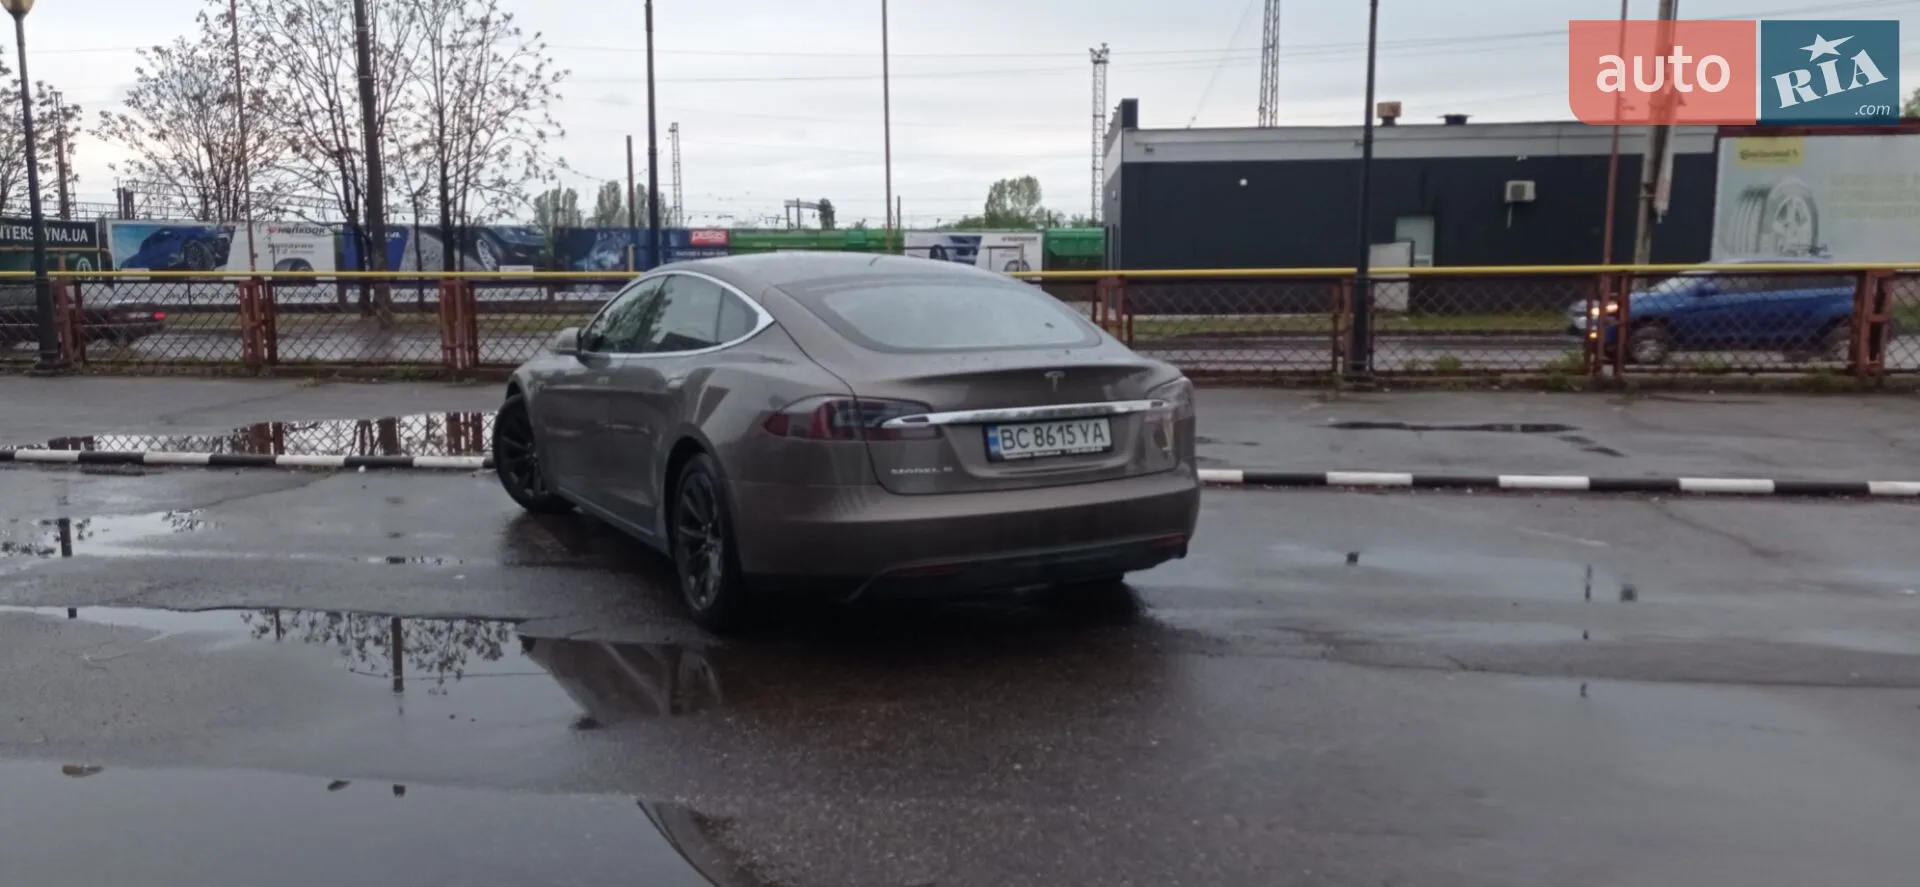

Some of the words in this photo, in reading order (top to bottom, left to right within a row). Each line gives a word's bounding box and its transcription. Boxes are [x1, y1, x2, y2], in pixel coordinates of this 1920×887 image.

[1001, 427, 1031, 450] BC
[1034, 424, 1076, 447] 8615
[1079, 422, 1105, 444] YA
